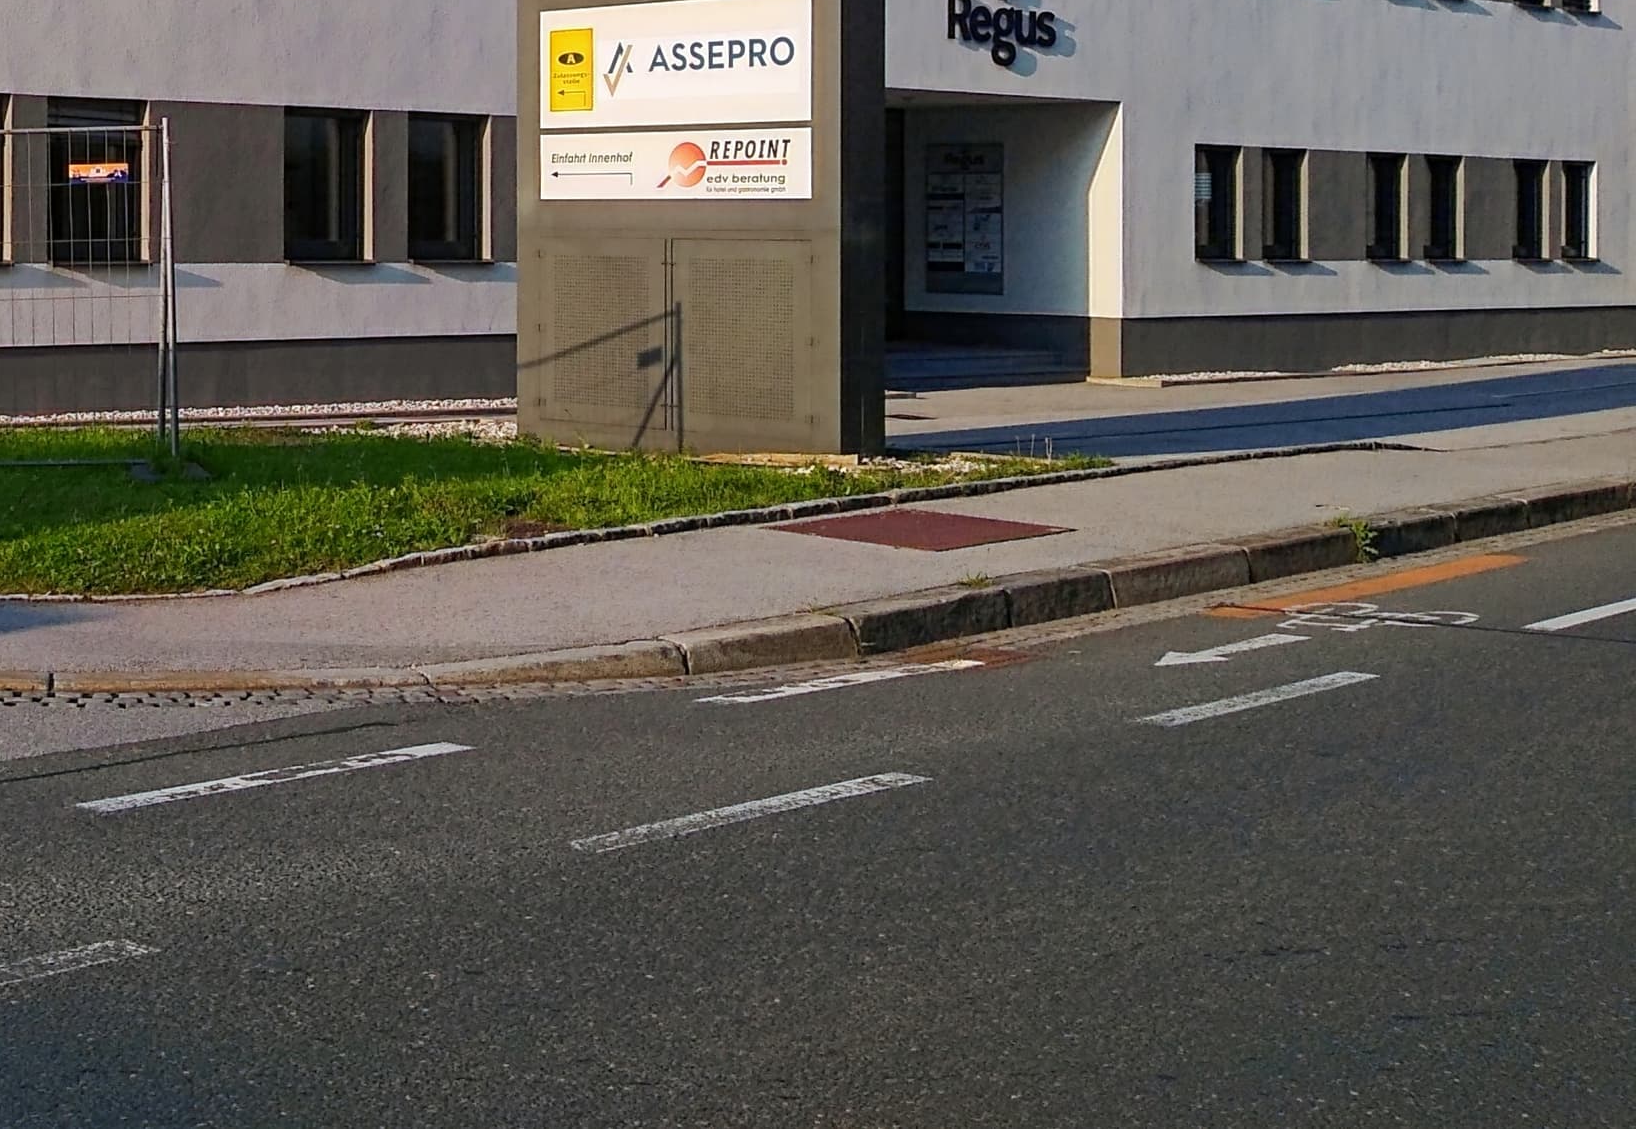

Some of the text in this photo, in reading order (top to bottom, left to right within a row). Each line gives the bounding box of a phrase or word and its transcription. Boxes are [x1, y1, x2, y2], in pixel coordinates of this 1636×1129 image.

[567, 54, 575, 64] A
[648, 36, 795, 72] ASSEPRO
[709, 139, 791, 160] REPOINT
[551, 151, 633, 164] Einfahrt Innenhof
[706, 173, 786, 185] edv beratung
